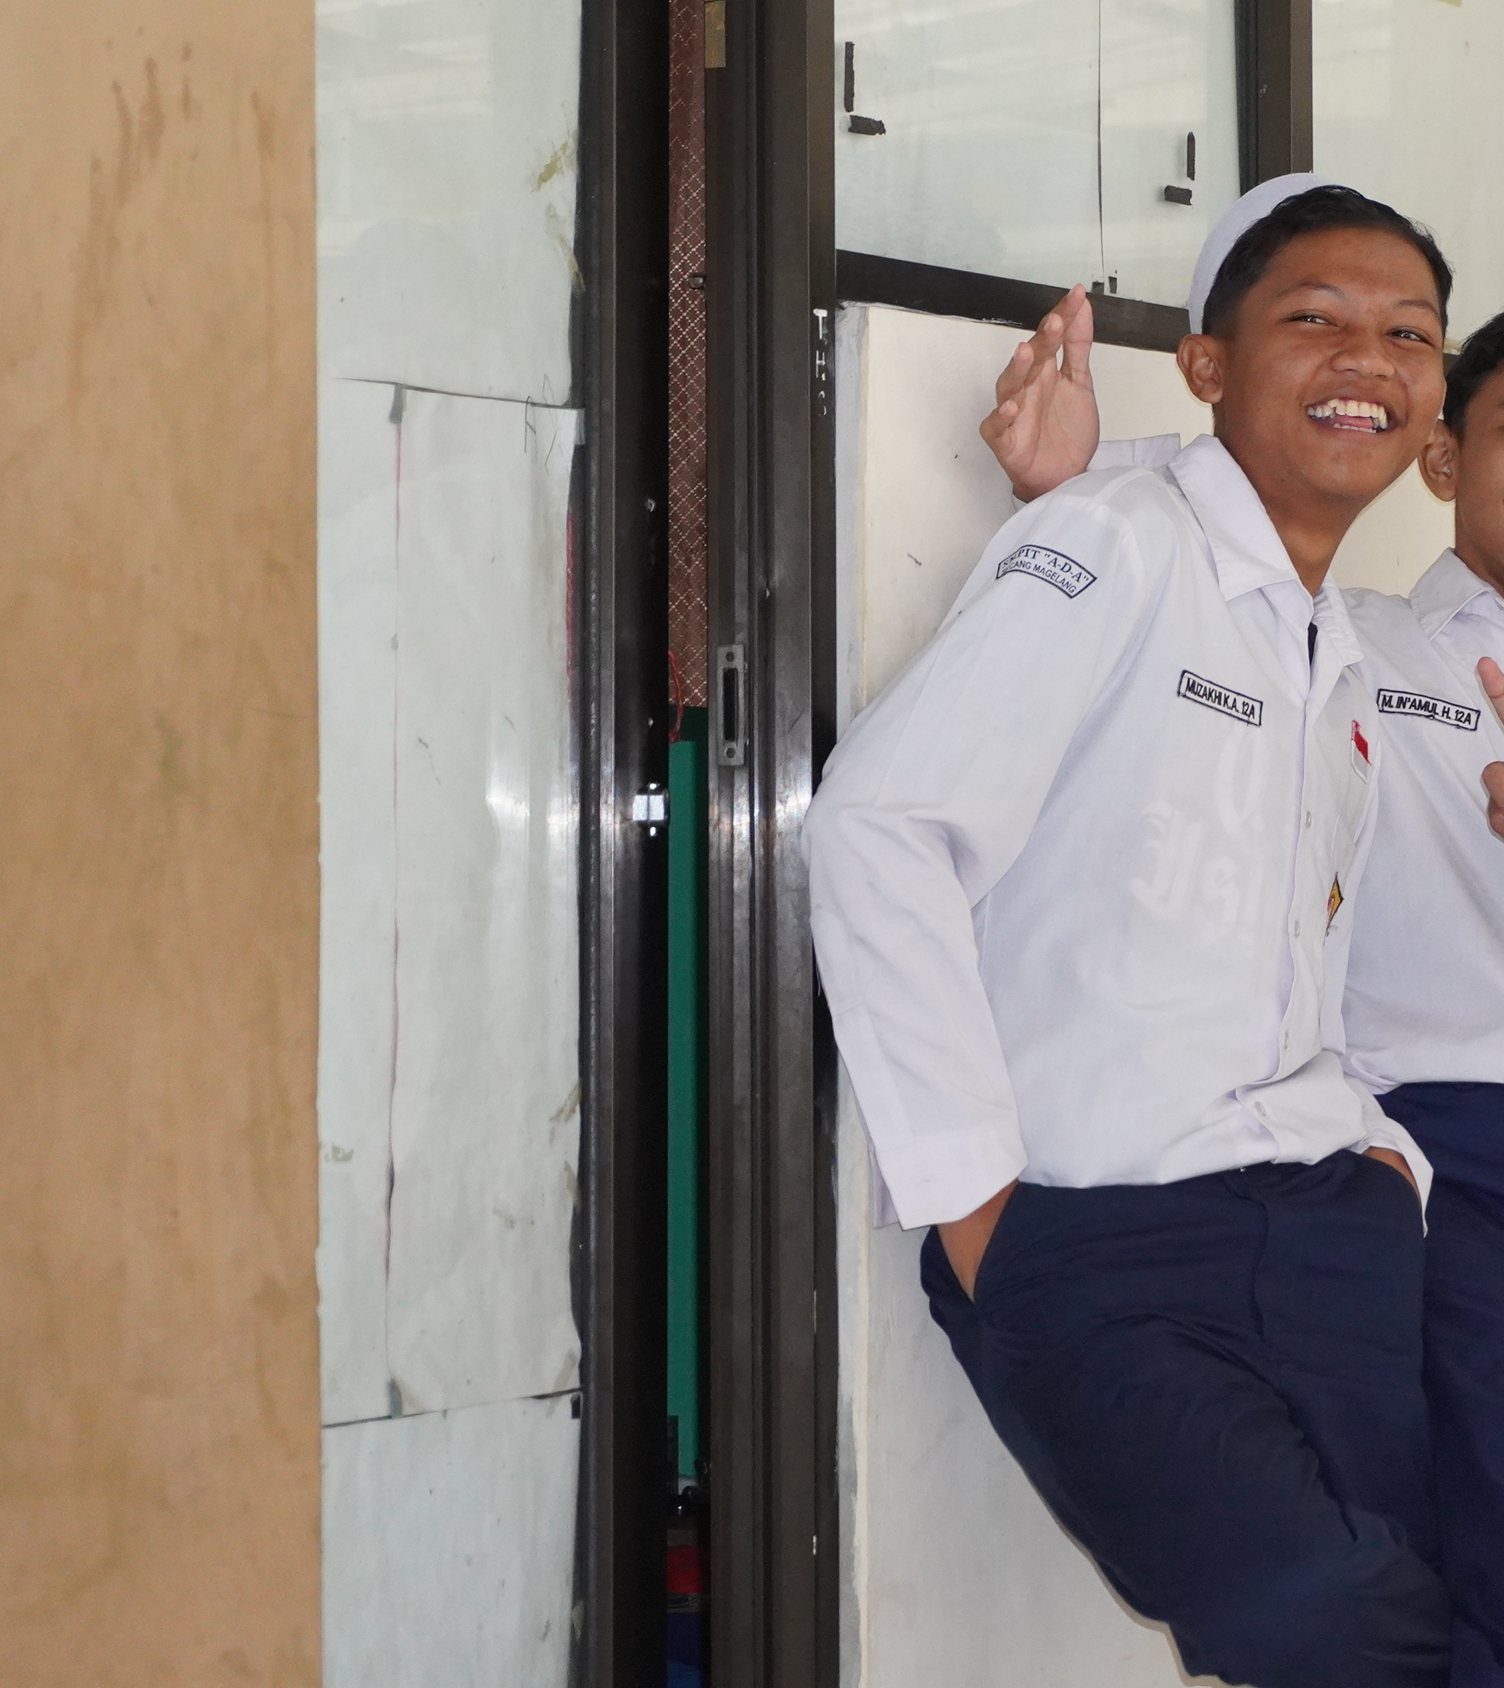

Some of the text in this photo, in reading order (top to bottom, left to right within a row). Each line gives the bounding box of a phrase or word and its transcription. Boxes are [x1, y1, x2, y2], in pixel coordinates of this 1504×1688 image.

[1033, 564, 1077, 594] MAGELANG
[1241, 700, 1255, 719] 12A
[1382, 694, 1393, 709] M.
[1454, 709, 1472, 725] 12A
